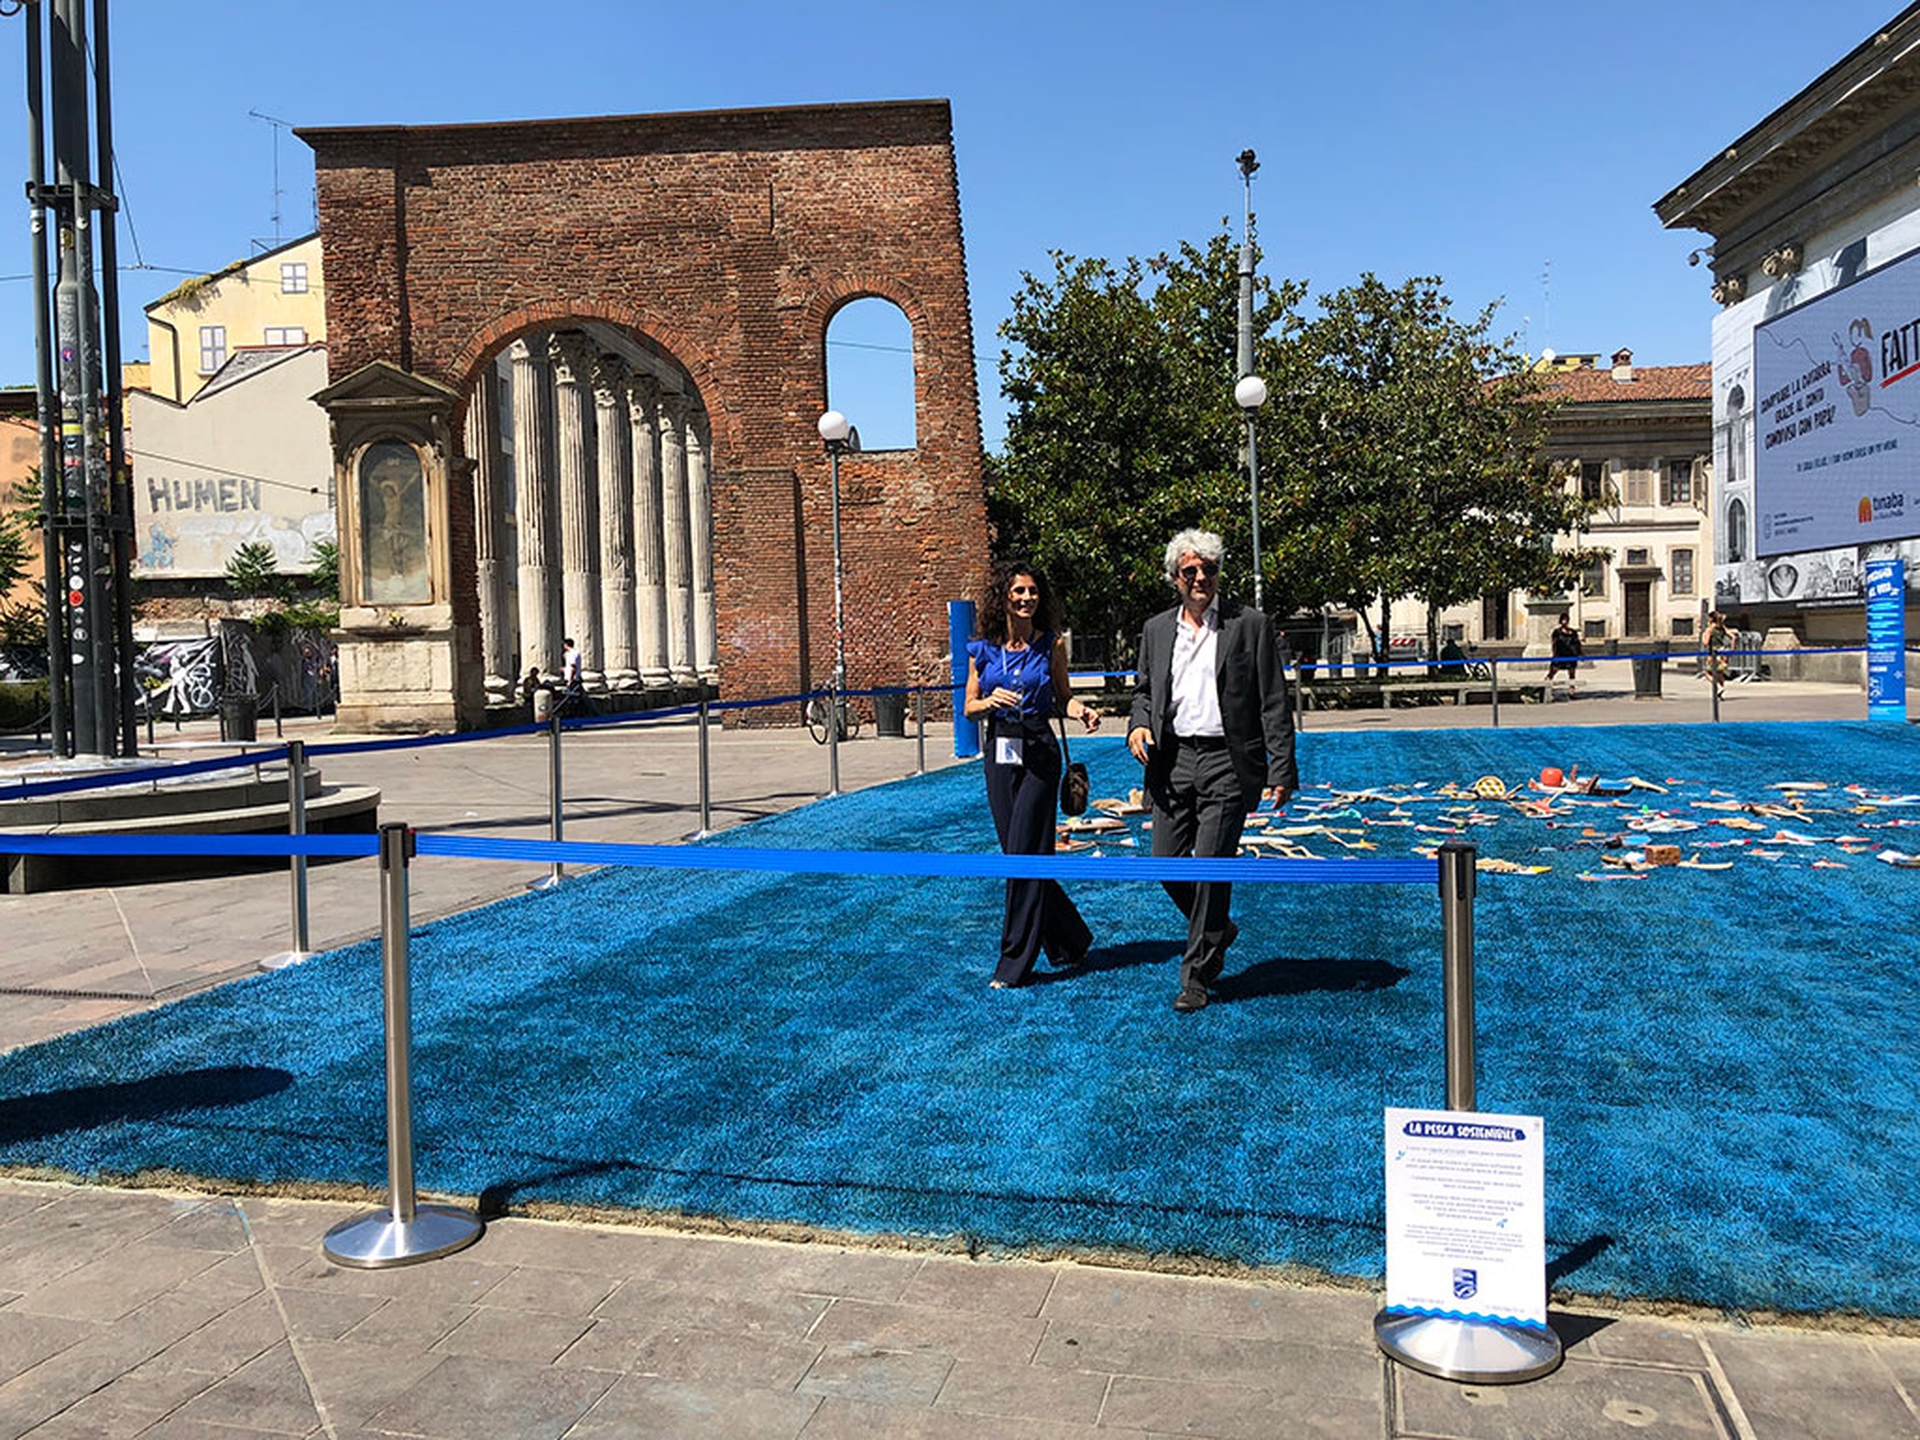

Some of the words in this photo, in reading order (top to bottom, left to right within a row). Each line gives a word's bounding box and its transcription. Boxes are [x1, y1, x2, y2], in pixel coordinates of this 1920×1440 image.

[147, 476, 261, 513] HUMEN
[1409, 1122, 1422, 1134] LA
[1424, 1123, 1455, 1137] PESCA
[1456, 1125, 1517, 1142] SOSTENIBILE
